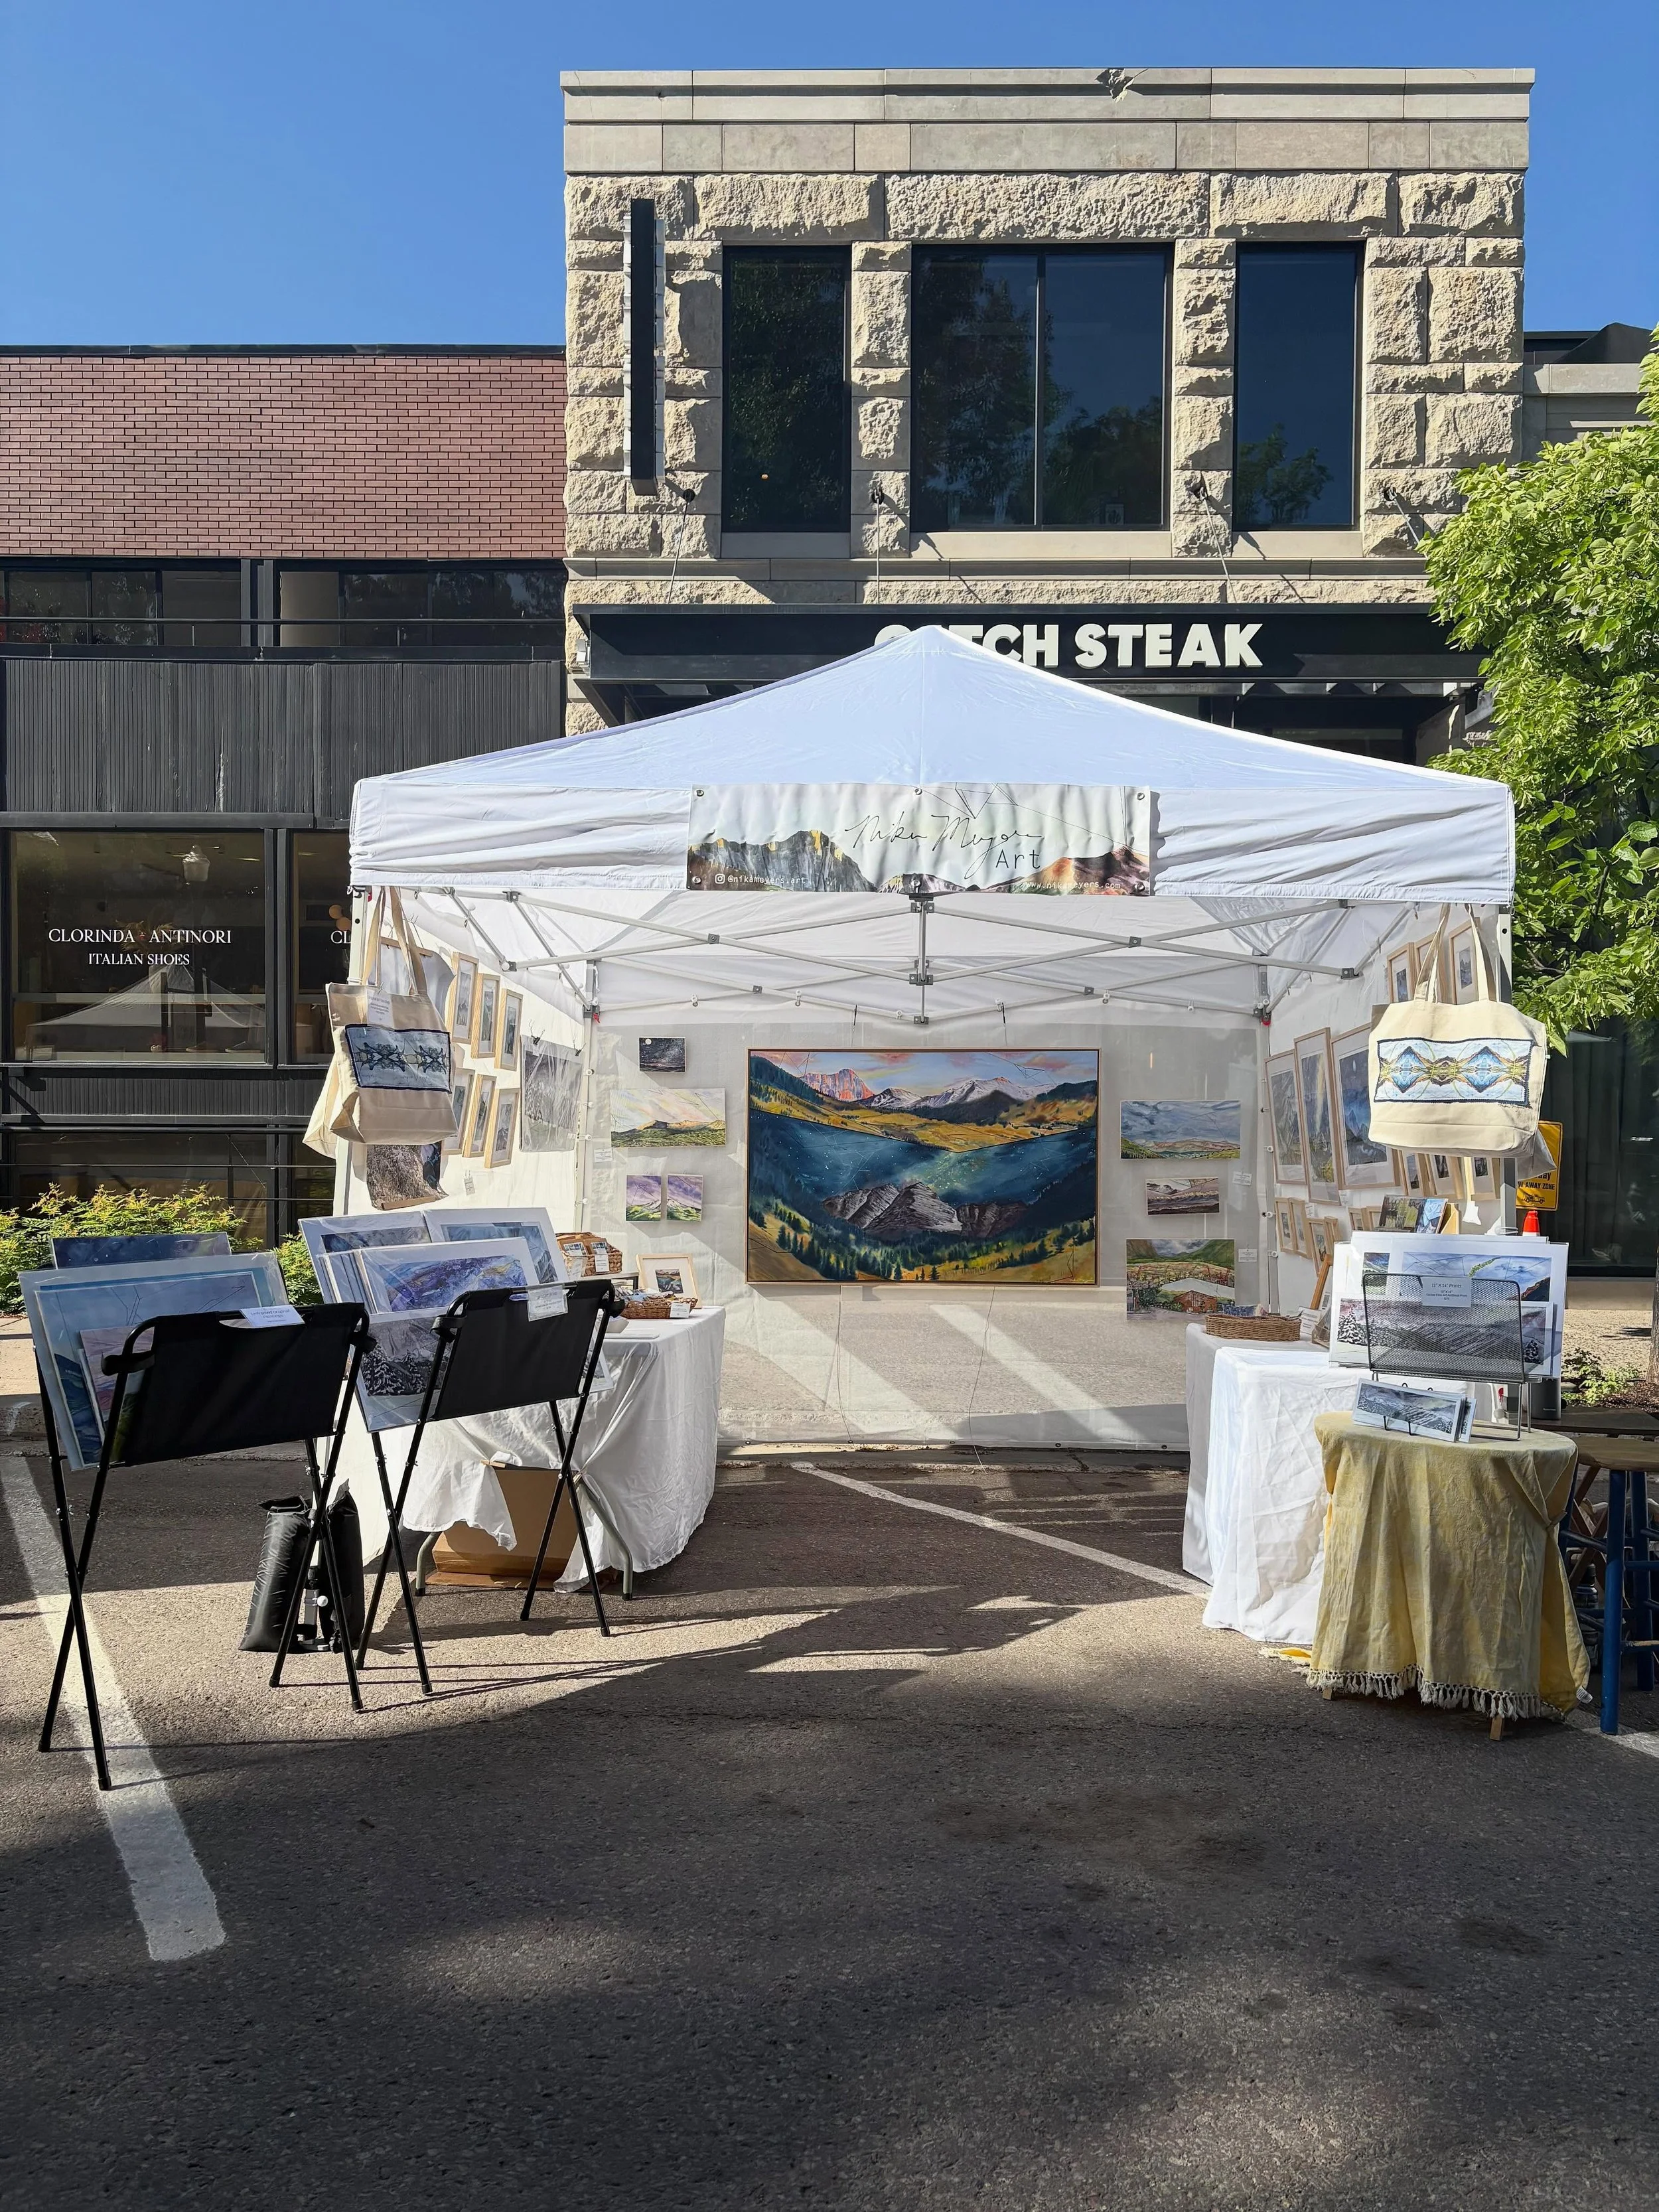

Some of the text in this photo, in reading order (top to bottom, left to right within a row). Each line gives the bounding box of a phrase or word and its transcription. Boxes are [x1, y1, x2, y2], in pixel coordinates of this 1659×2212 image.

[874, 623, 1263, 669] TCH STEAK
[995, 849, 1041, 869] Art
[727, 875, 806, 885] @nikameyers.art
[48, 928, 232, 944] CLORINDA ANTINORI
[88, 953, 190, 966] ITALIAN SHOES
